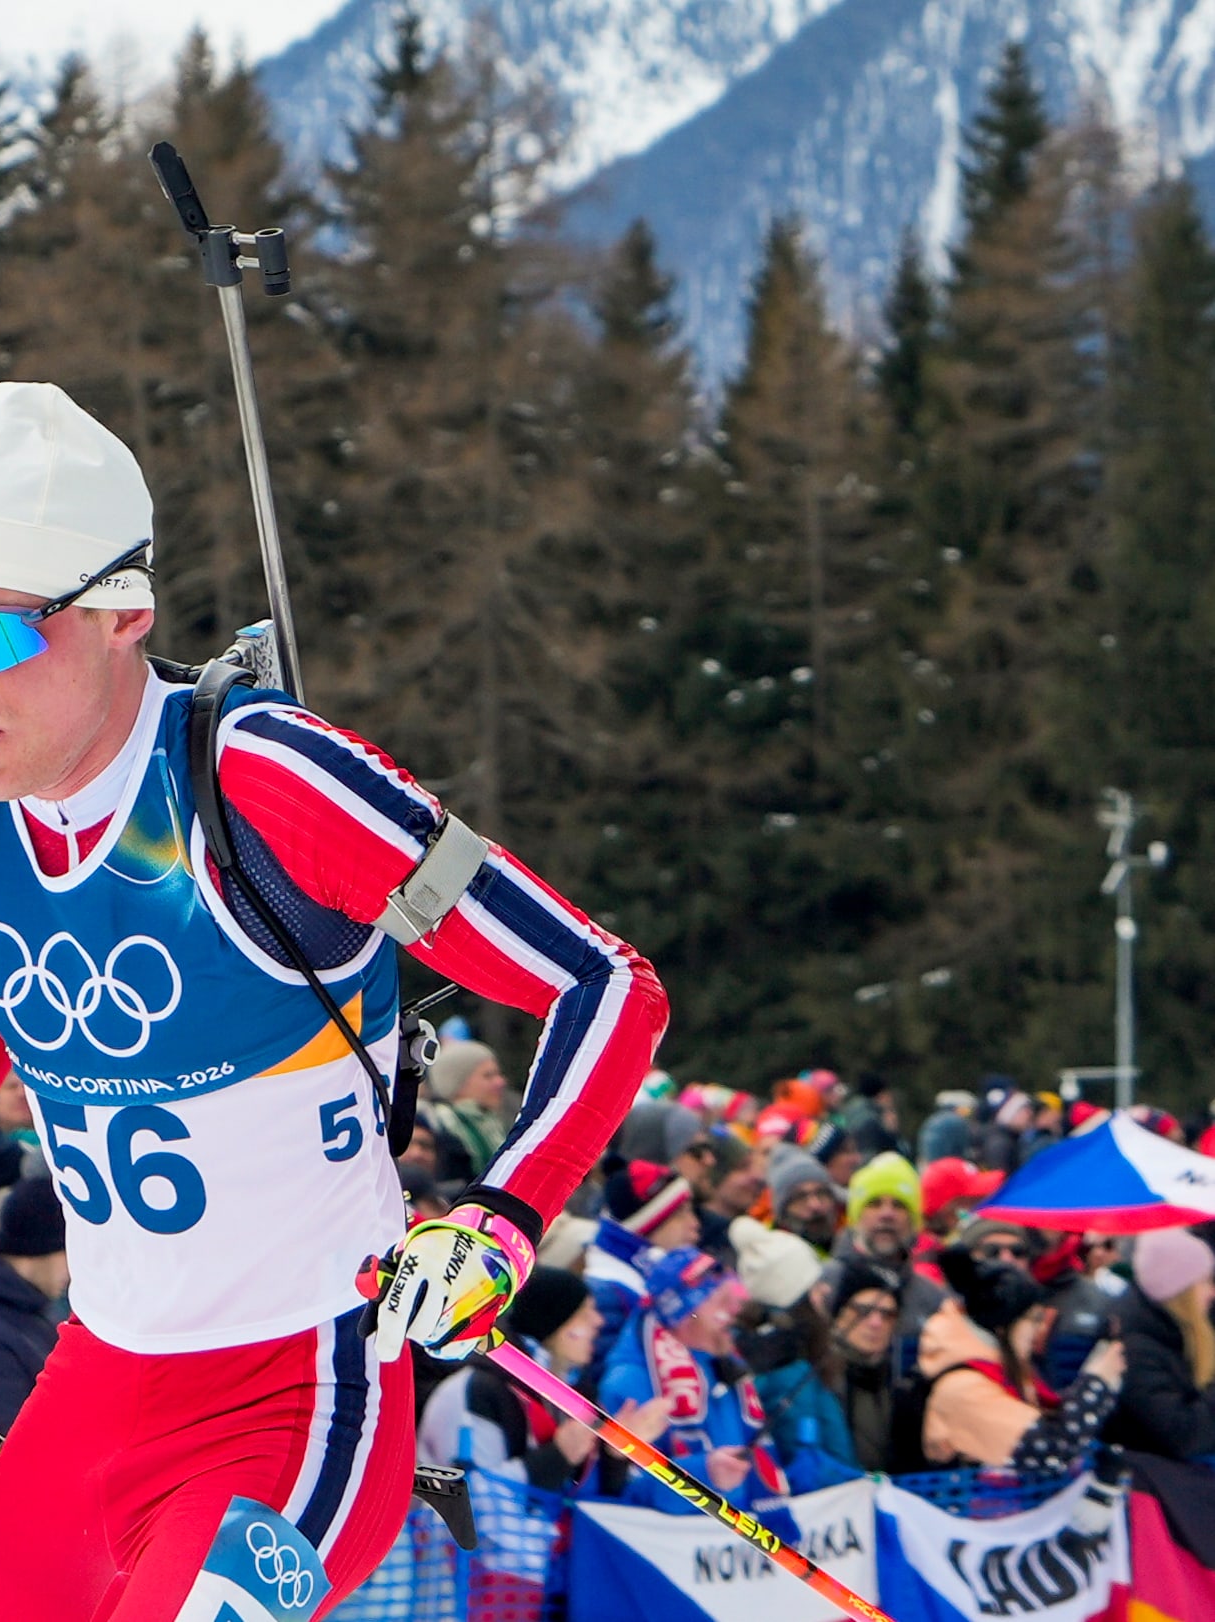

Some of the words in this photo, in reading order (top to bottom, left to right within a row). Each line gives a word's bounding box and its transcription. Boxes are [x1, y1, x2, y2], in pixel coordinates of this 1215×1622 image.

[65, 1076, 174, 1095] CORTINA
[177, 1061, 235, 1088] 2026
[36, 1093, 207, 1235] 56
[718, 1498, 781, 1554] LEKI
